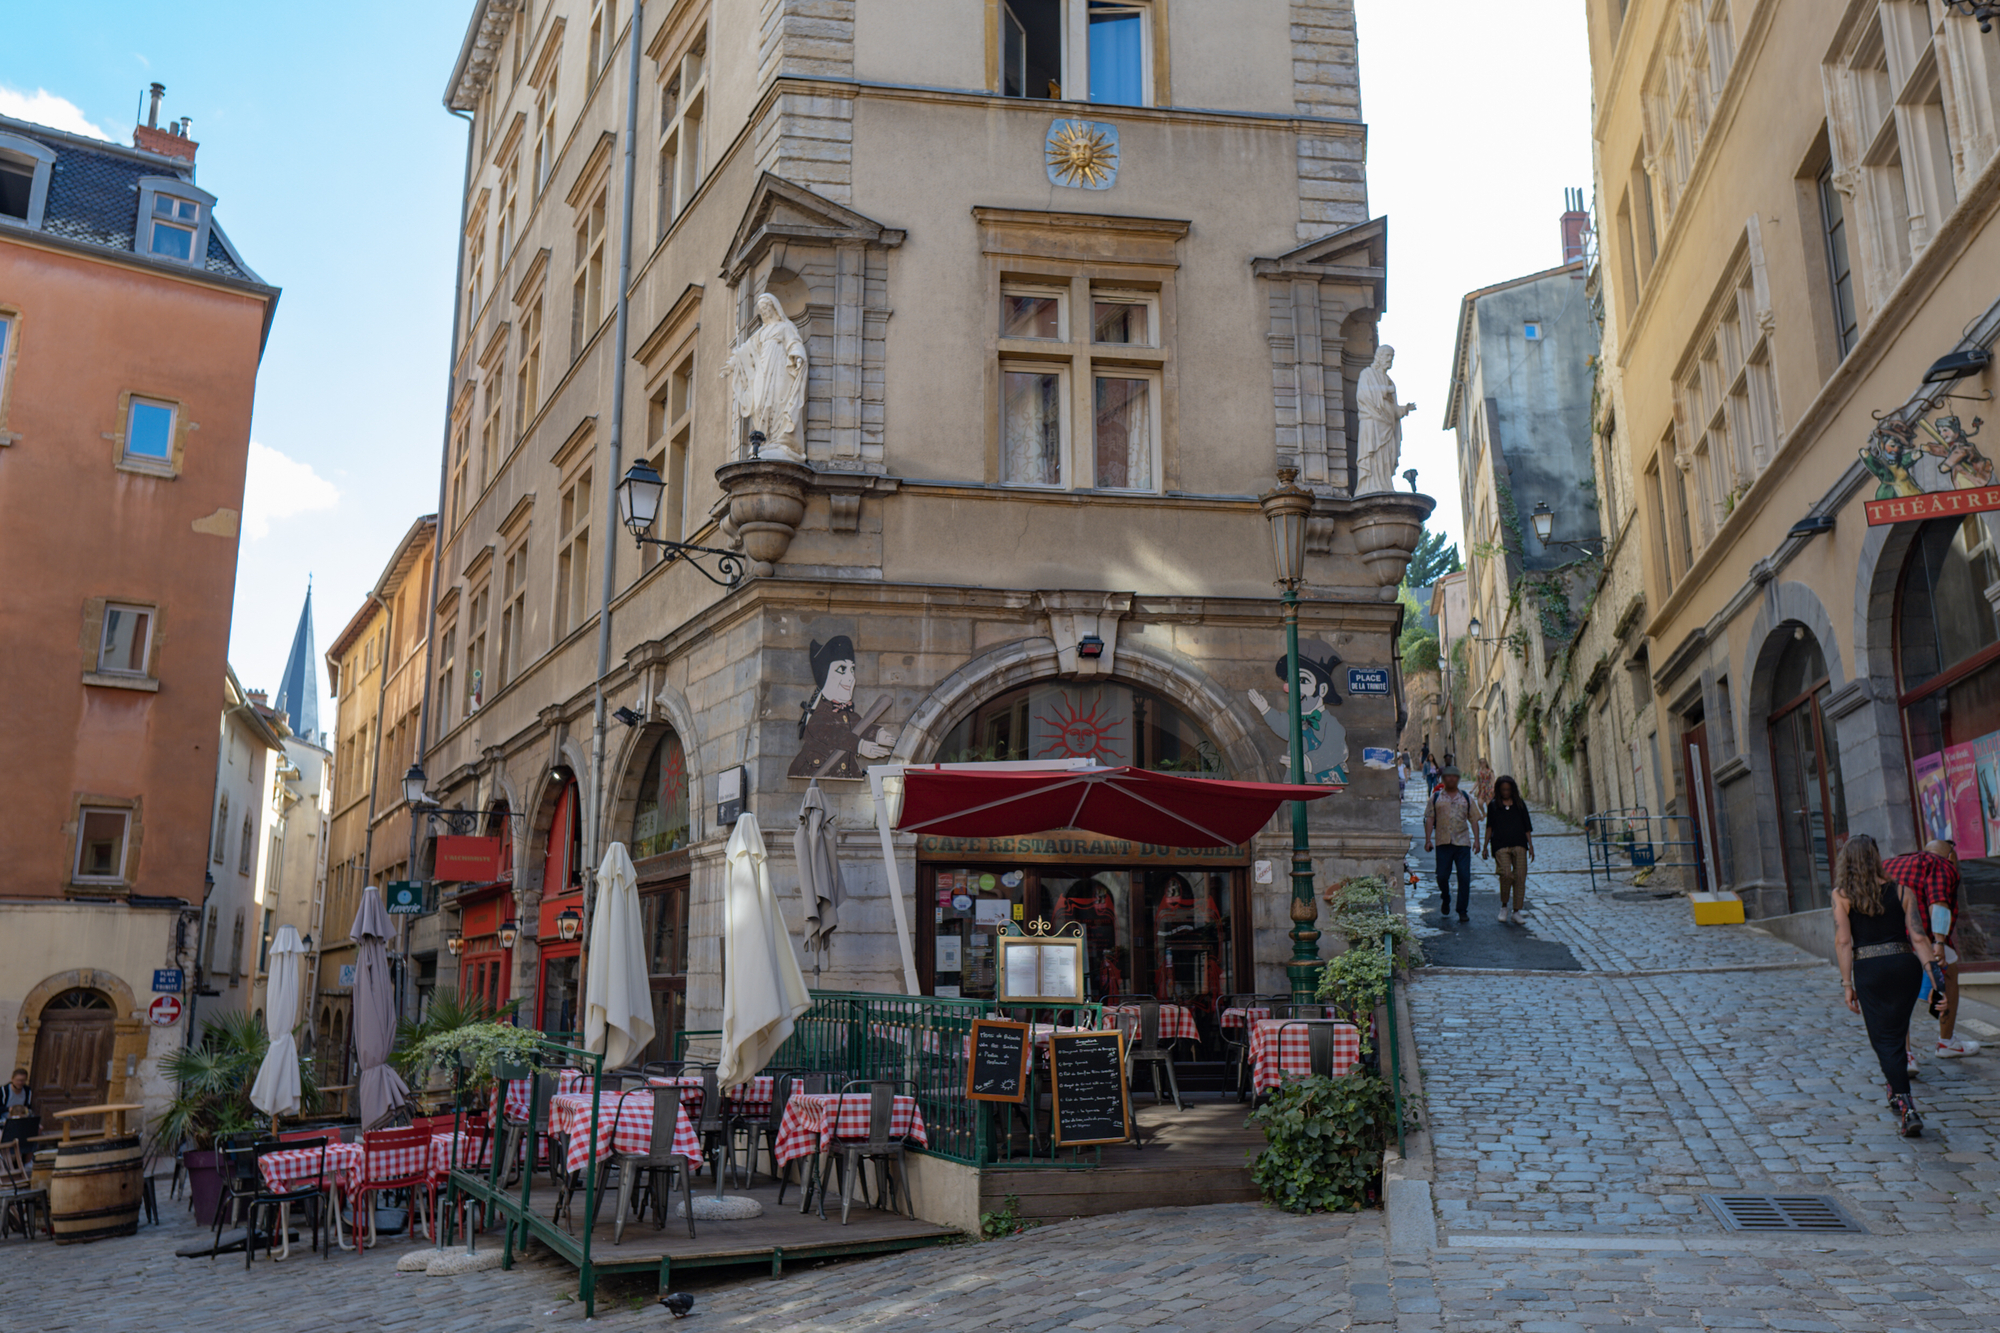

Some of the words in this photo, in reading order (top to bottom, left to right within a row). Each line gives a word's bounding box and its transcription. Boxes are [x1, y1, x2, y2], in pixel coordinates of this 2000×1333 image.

[1869, 491, 2000, 520] THÉÂTRE
[1356, 674, 1381, 682] PLACE
[1367, 682, 1386, 690] TRINITÉ
[986, 837, 1132, 857] RESTAURANT
[1138, 842, 1171, 858] DU
[1176, 847, 1245, 858] SOLEIL
[388, 903, 421, 913] Laverie
